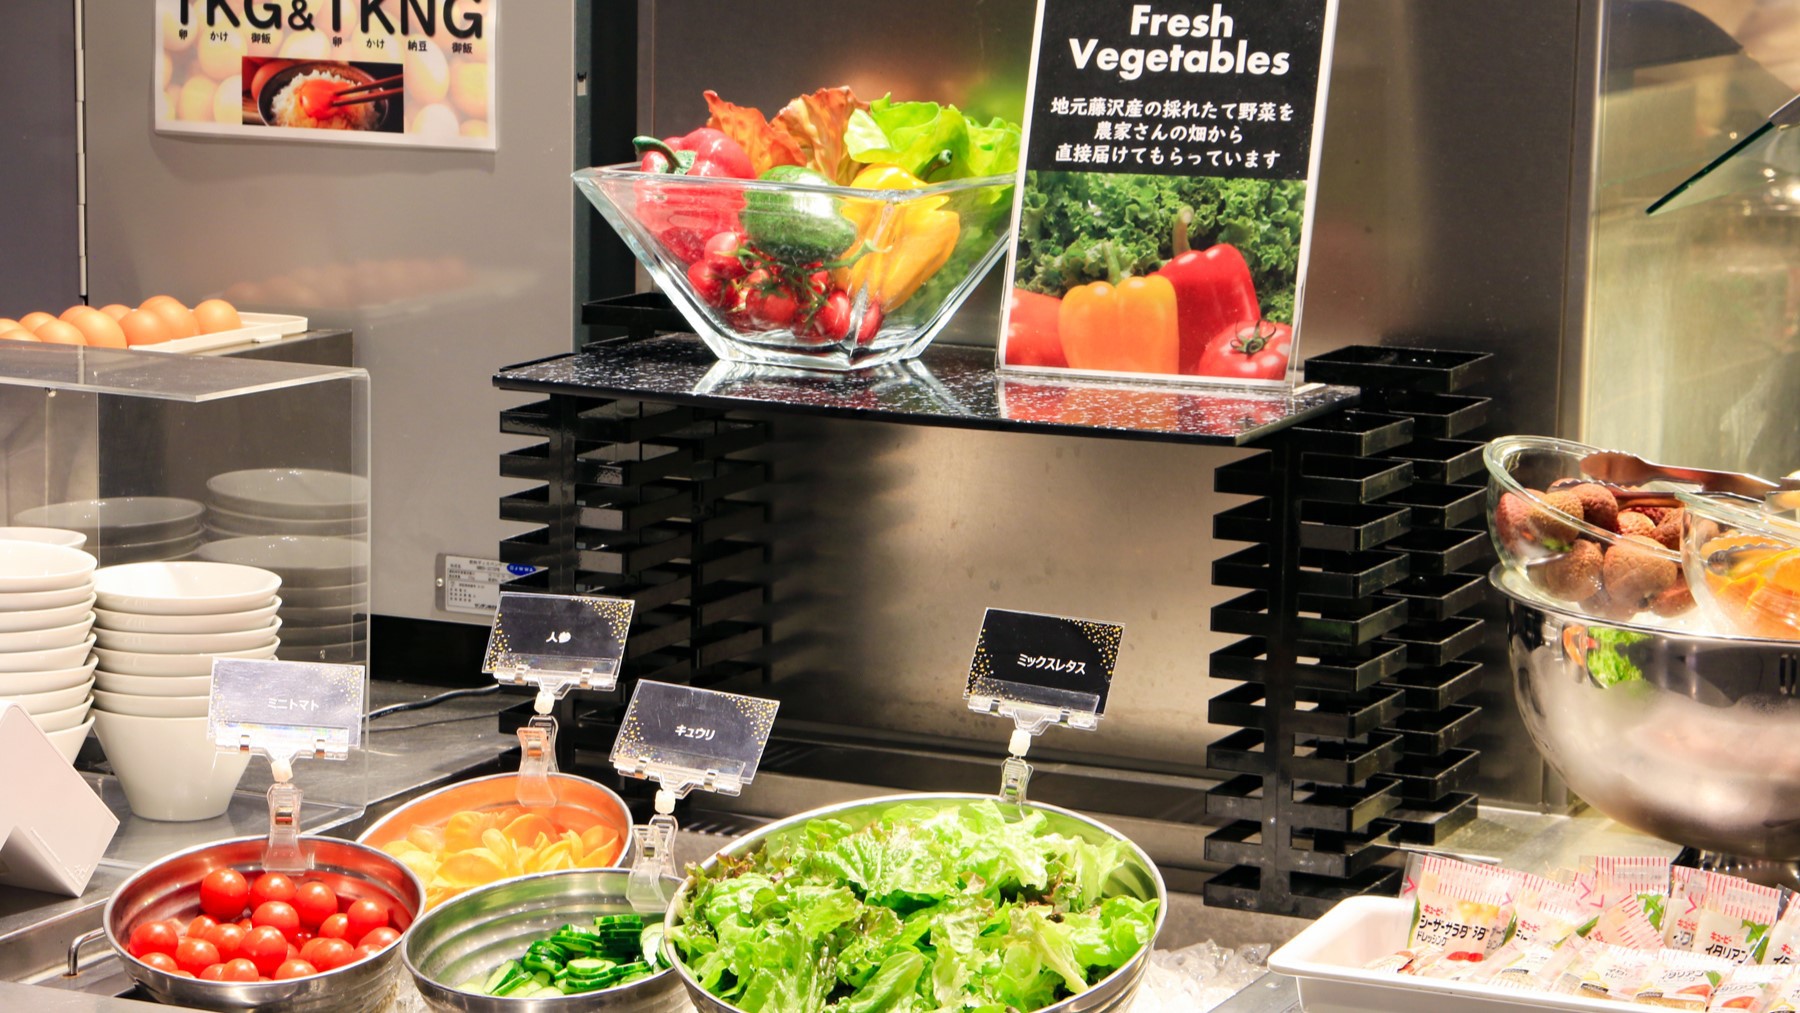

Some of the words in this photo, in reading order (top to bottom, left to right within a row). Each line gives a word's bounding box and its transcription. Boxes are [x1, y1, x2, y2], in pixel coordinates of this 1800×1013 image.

[1130, 3, 1234, 38] Fresh
[178, 29, 188, 41] 卵
[210, 31, 229, 42] かけ
[250, 32, 272, 45] 御飯
[332, 35, 343, 48] 卵
[366, 38, 385, 49] かけ
[407, 40, 428, 52] 納豆
[451, 42, 473, 54] 御飯
[1068, 38, 1290, 81] Vegetables
[1050, 96, 1294, 123] 地元藤沢産の採れたて野菜を
[1093, 121, 1244, 144] 農家さんの畑から
[1054, 142, 1281, 170] 直接届けてもらっています
[1017, 653, 1087, 675] ミックスレタス
[267, 697, 320, 711] ミニトマト
[674, 723, 716, 741] キュウリ
[1704, 943, 1748, 964] イタリアン
